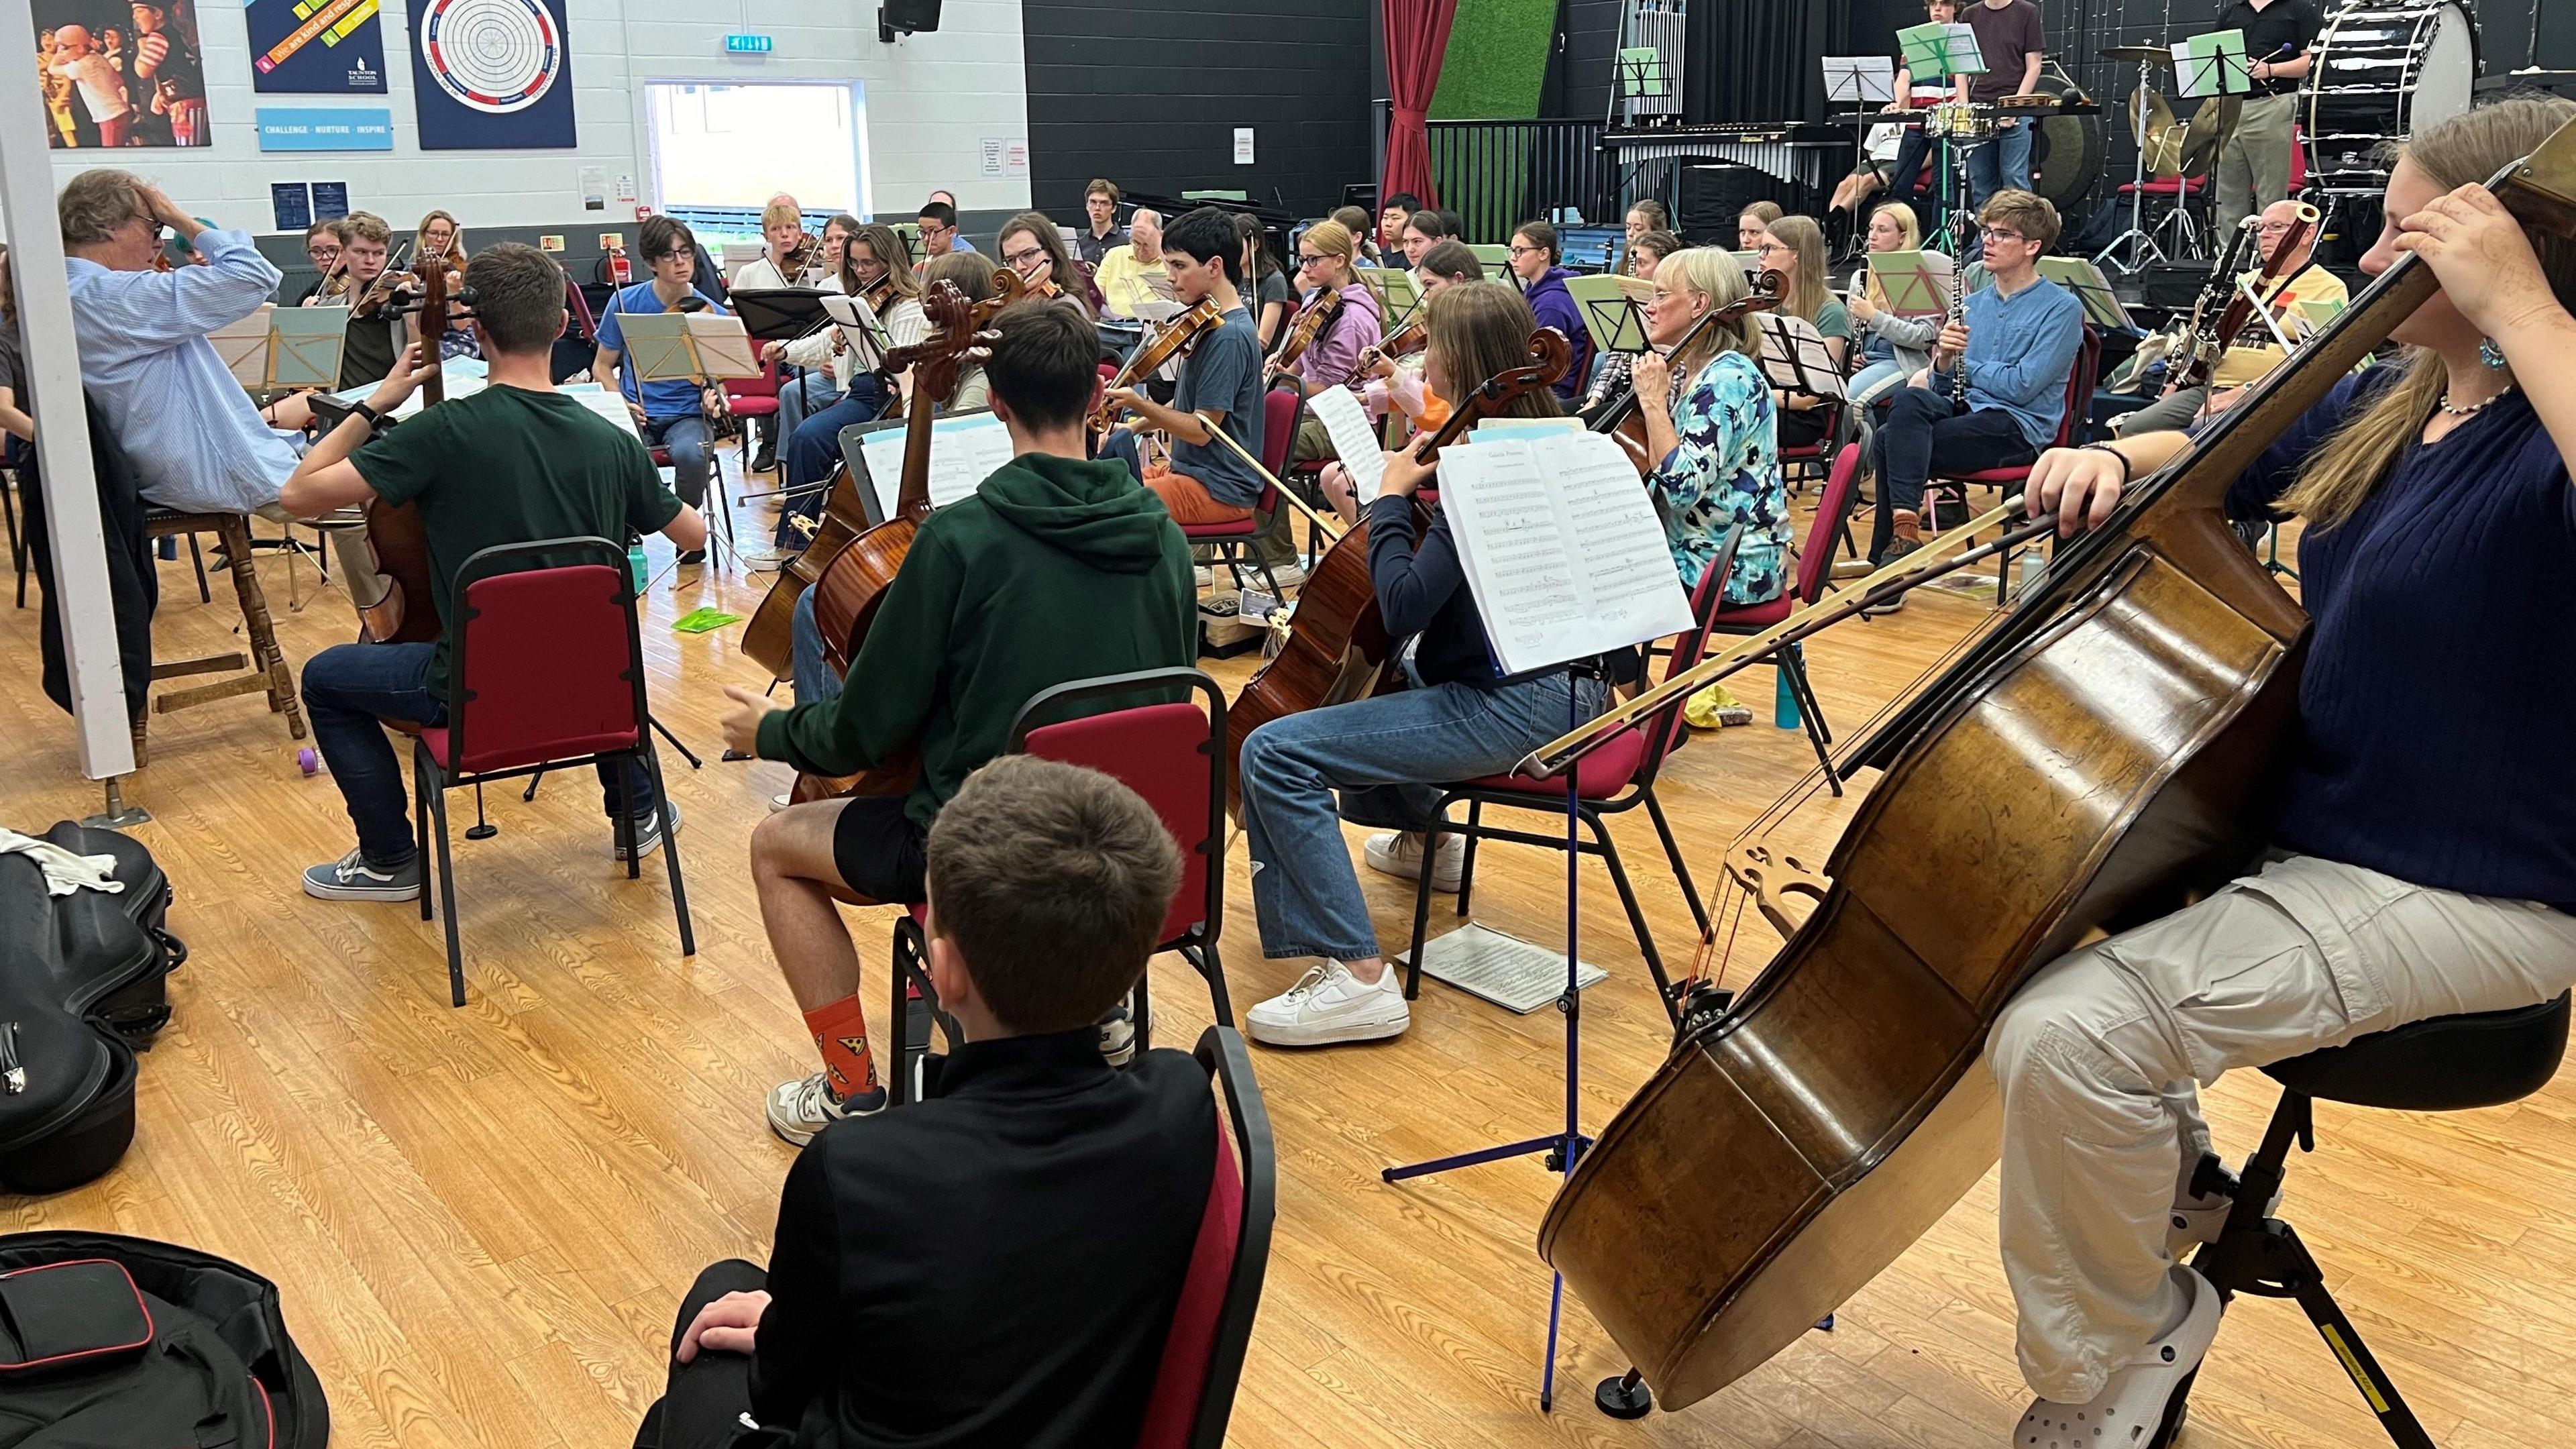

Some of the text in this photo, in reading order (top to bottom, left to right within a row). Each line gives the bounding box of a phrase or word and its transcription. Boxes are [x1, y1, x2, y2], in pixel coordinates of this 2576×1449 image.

[288, 36, 303, 49] are
[299, 20, 321, 39] kind
[319, 9, 335, 25] and
[265, 125, 386, 134] CHALLENGE NURTURE INSPIRE
